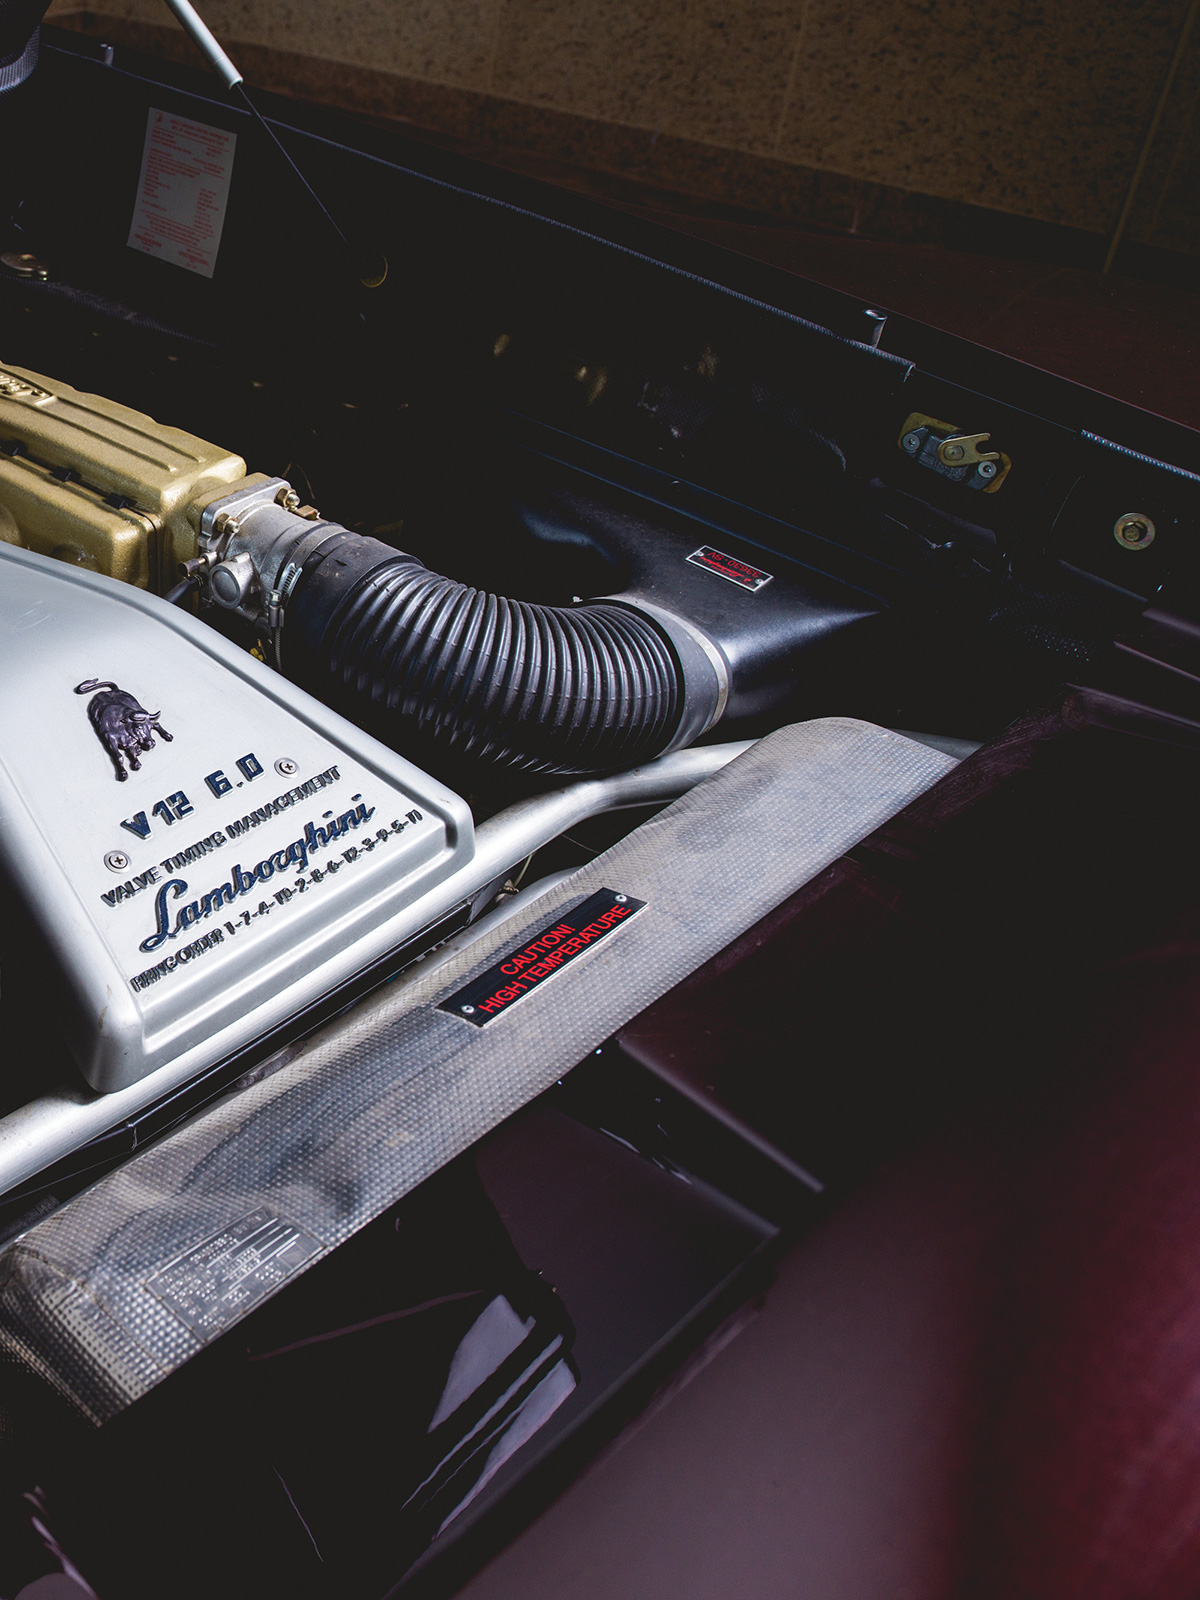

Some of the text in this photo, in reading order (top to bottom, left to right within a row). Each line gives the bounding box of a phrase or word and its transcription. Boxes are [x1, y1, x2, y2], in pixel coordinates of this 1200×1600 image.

[706, 551, 762, 578] 33630-SV
[204, 752, 266, 799] 6.0
[100, 764, 343, 908] VALVE TIMING MANAGEMENT
[138, 793, 377, 954] Lamborghini
[129, 955, 179, 993] FIRING
[174, 927, 225, 965] ORDER
[478, 904, 632, 1014] HIGH TEMPERATURE
[500, 923, 576, 976] CAUTION!
